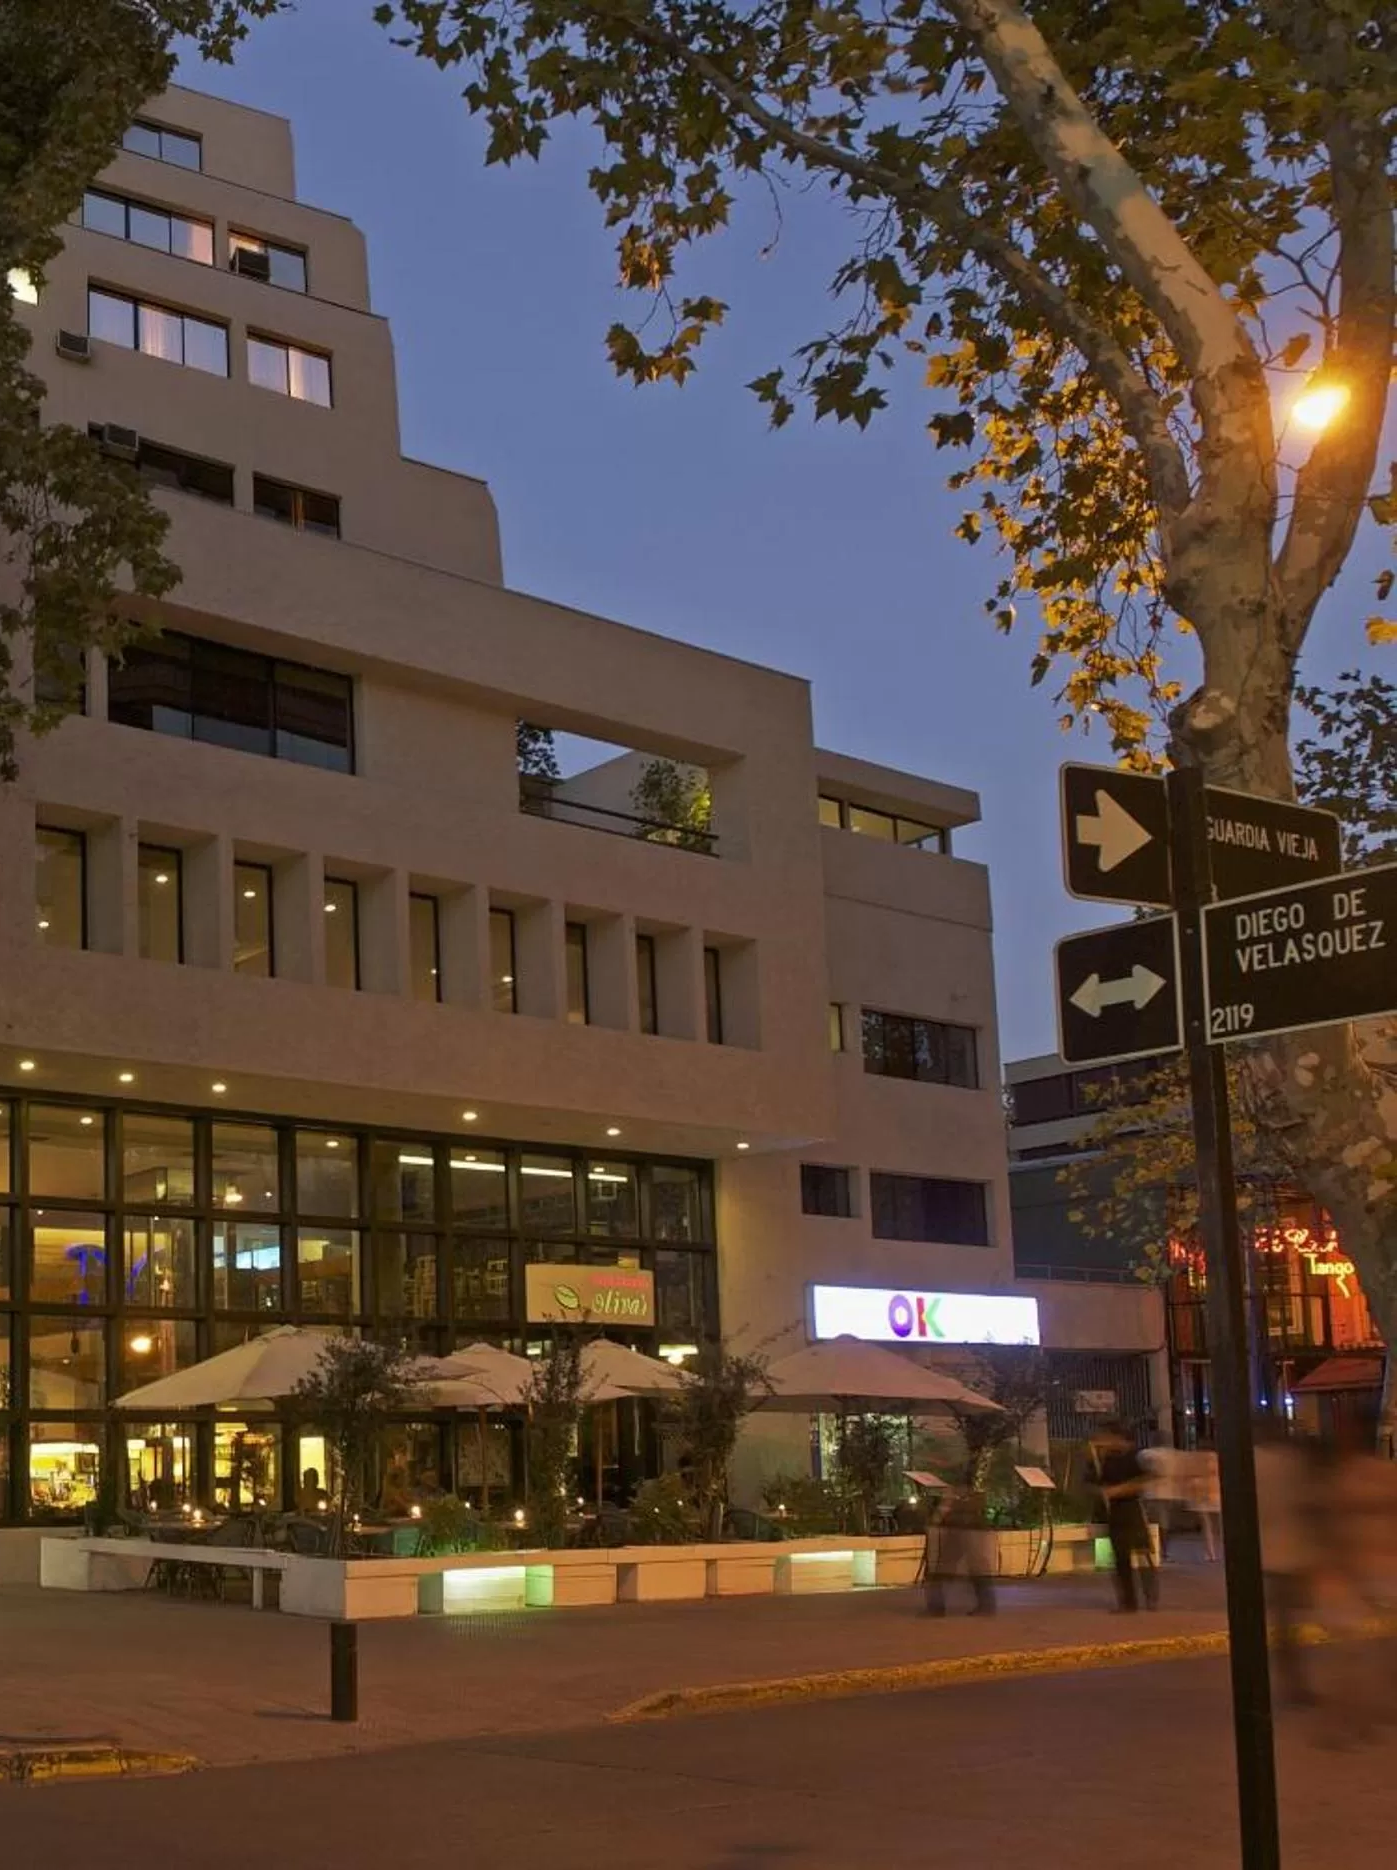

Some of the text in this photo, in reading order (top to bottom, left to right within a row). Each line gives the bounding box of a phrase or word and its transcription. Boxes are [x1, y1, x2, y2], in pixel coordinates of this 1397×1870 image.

[1206, 815, 1319, 861] GUARDIA VIEJA
[1236, 889, 1367, 941] DIEGO DE
[1236, 921, 1386, 973] VELASQUEZ
[1211, 1004, 1254, 1034] 2119
[888, 1294, 945, 1338] OK
